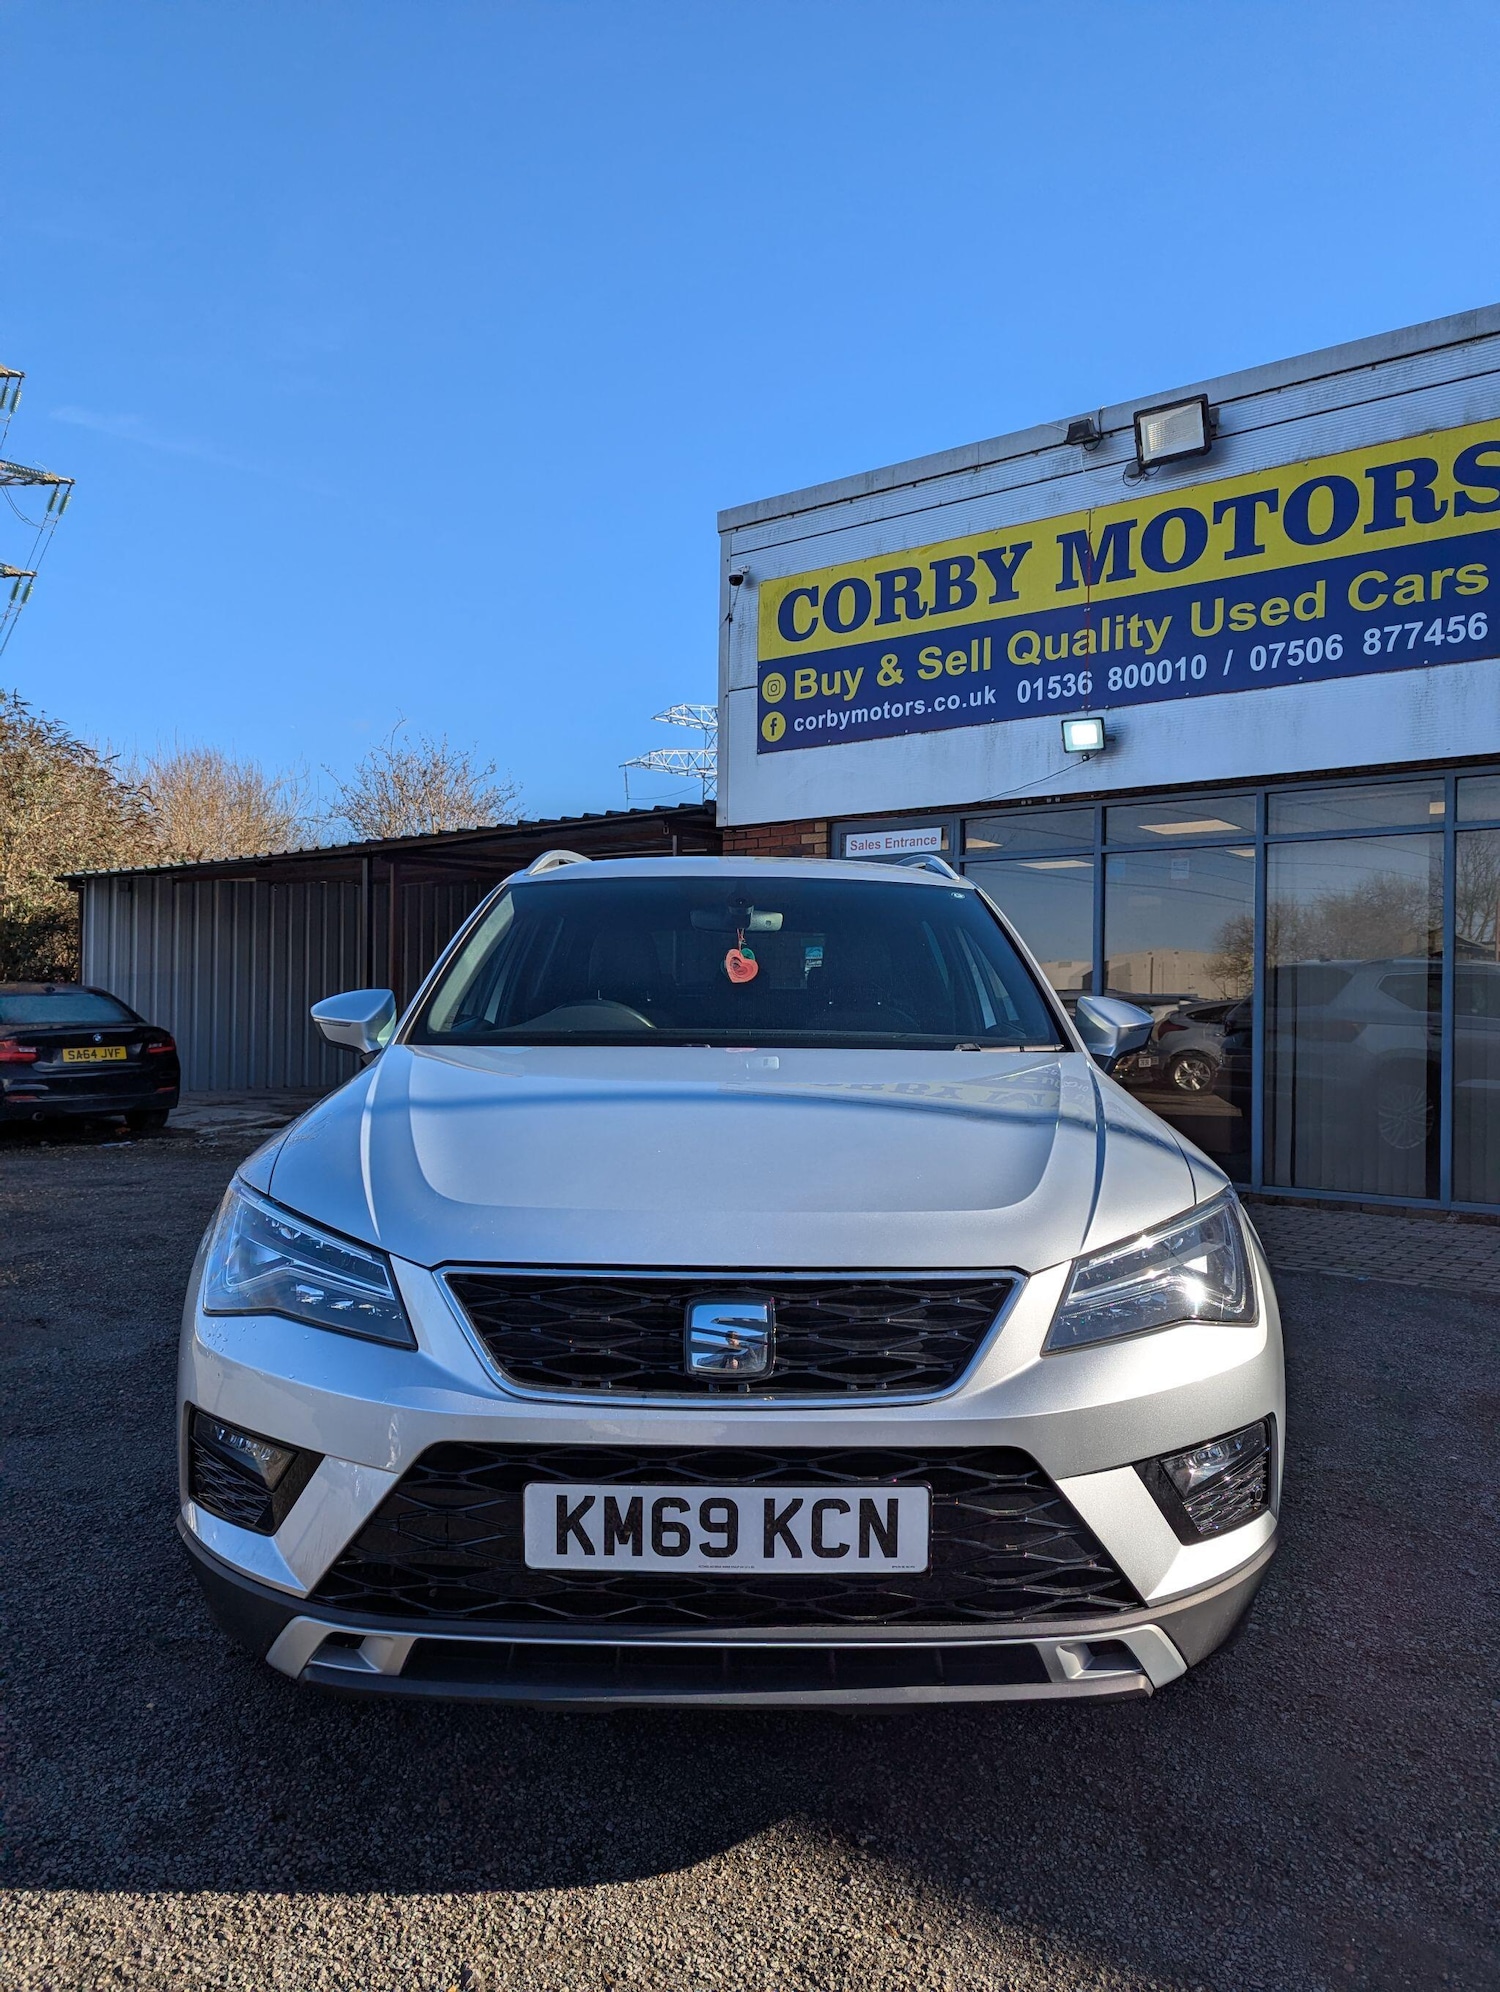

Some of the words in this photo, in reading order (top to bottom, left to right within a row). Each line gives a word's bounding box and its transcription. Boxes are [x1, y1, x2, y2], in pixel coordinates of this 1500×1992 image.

[777, 540, 1034, 642] CORBY
[1055, 440, 1500, 592] MOTORS
[793, 667, 864, 701] Buy
[876, 653, 905, 688] &
[917, 637, 992, 681] Sell
[1007, 613, 1173, 666] Quality
[1191, 579, 1326, 638] Used
[1347, 563, 1489, 612] Cars
[793, 685, 997, 732] corbymotors.co.uk
[1017, 671, 1093, 704] 01536
[1107, 654, 1207, 692] 800010
[1222, 649, 1234, 677] /
[1249, 634, 1344, 672] 07506
[1362, 612, 1488, 656] 877456
[850, 839, 881, 851] Sales
[885, 836, 938, 849] Entrance
[68, 1049, 97, 1060] SA64
[101, 1048, 121, 1059] JVF
[556, 1495, 739, 1558] KM69
[763, 1498, 899, 1559] KCN
